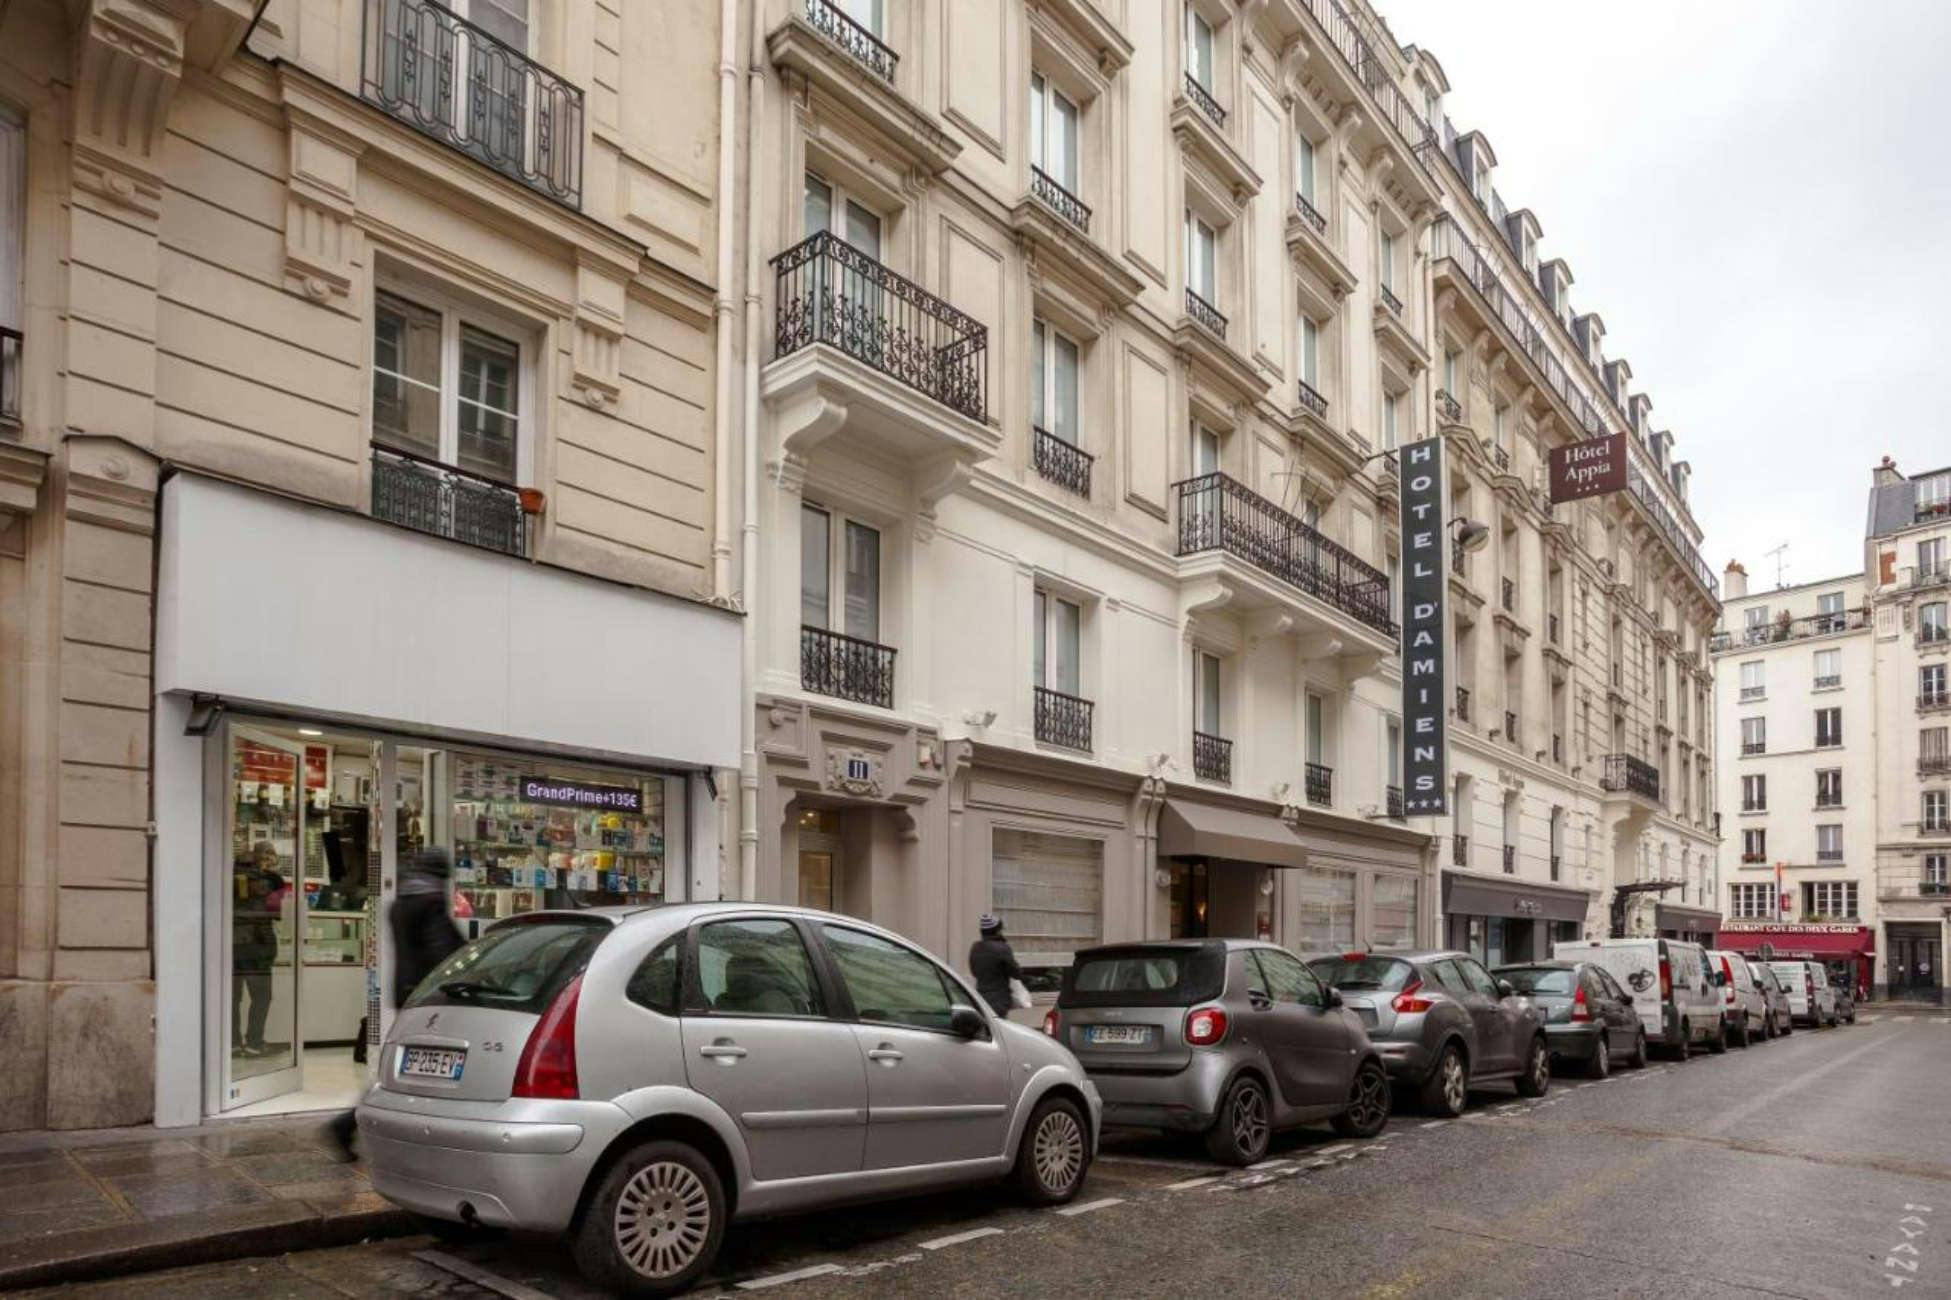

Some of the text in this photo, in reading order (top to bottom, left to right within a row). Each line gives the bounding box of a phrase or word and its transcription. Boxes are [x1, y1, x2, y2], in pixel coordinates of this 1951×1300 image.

[1565, 440, 1610, 464] Hôtel
[1565, 460, 1611, 484] Appia
[1411, 446, 1433, 578] HOTEL
